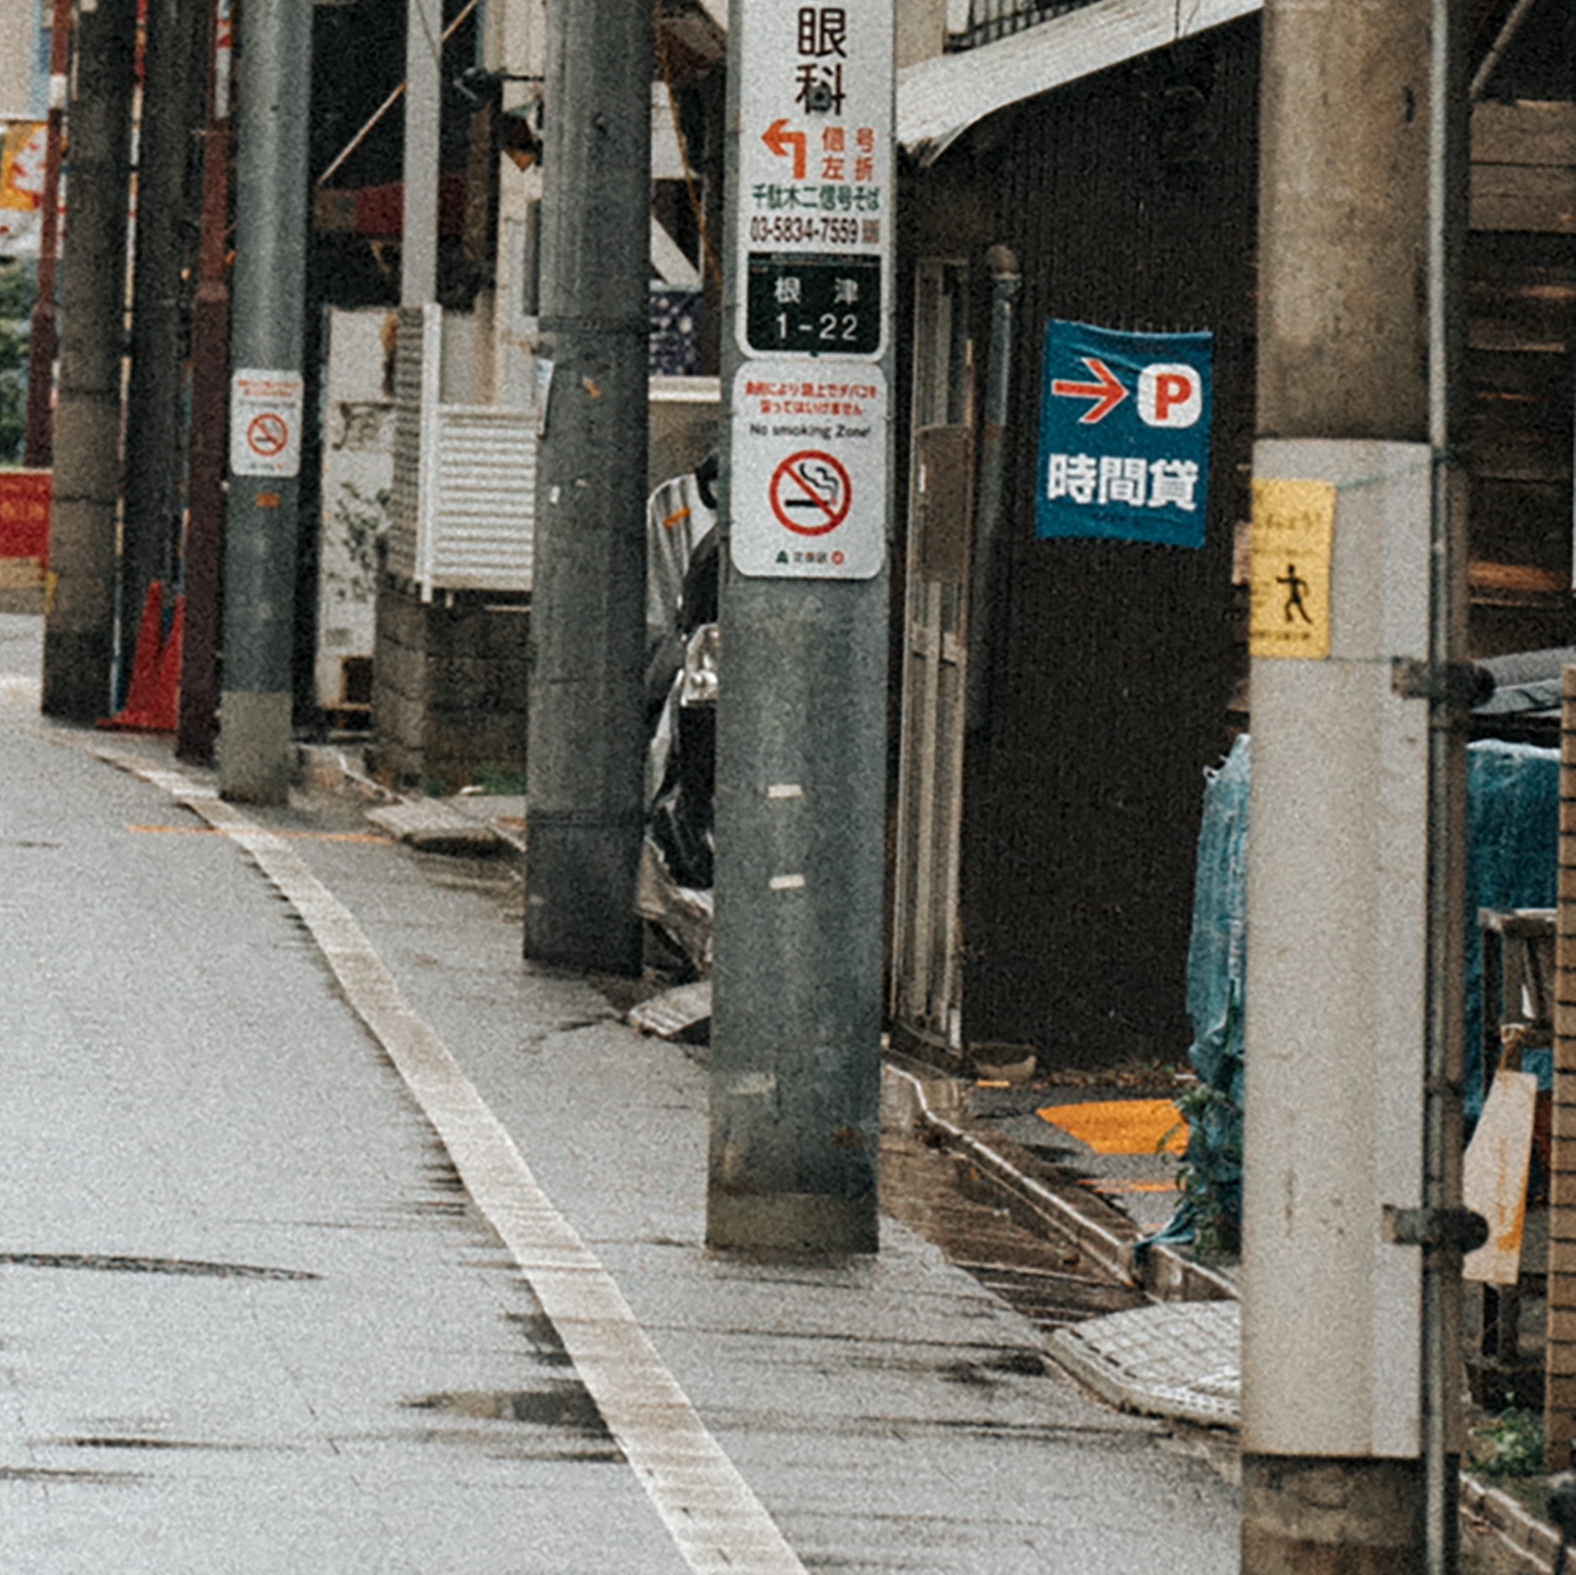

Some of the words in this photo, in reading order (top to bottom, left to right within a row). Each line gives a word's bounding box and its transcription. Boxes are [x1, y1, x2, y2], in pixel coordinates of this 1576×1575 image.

[821, 155, 875, 182] 左折
[750, 216, 859, 244] 03-5834-7559
[776, 313, 859, 341] 1-22
[1155, 373, 1192, 420] P
[750, 423, 768, 436] No
[773, 423, 832, 440] smoking
[1047, 453, 1199, 511] 時間貸
